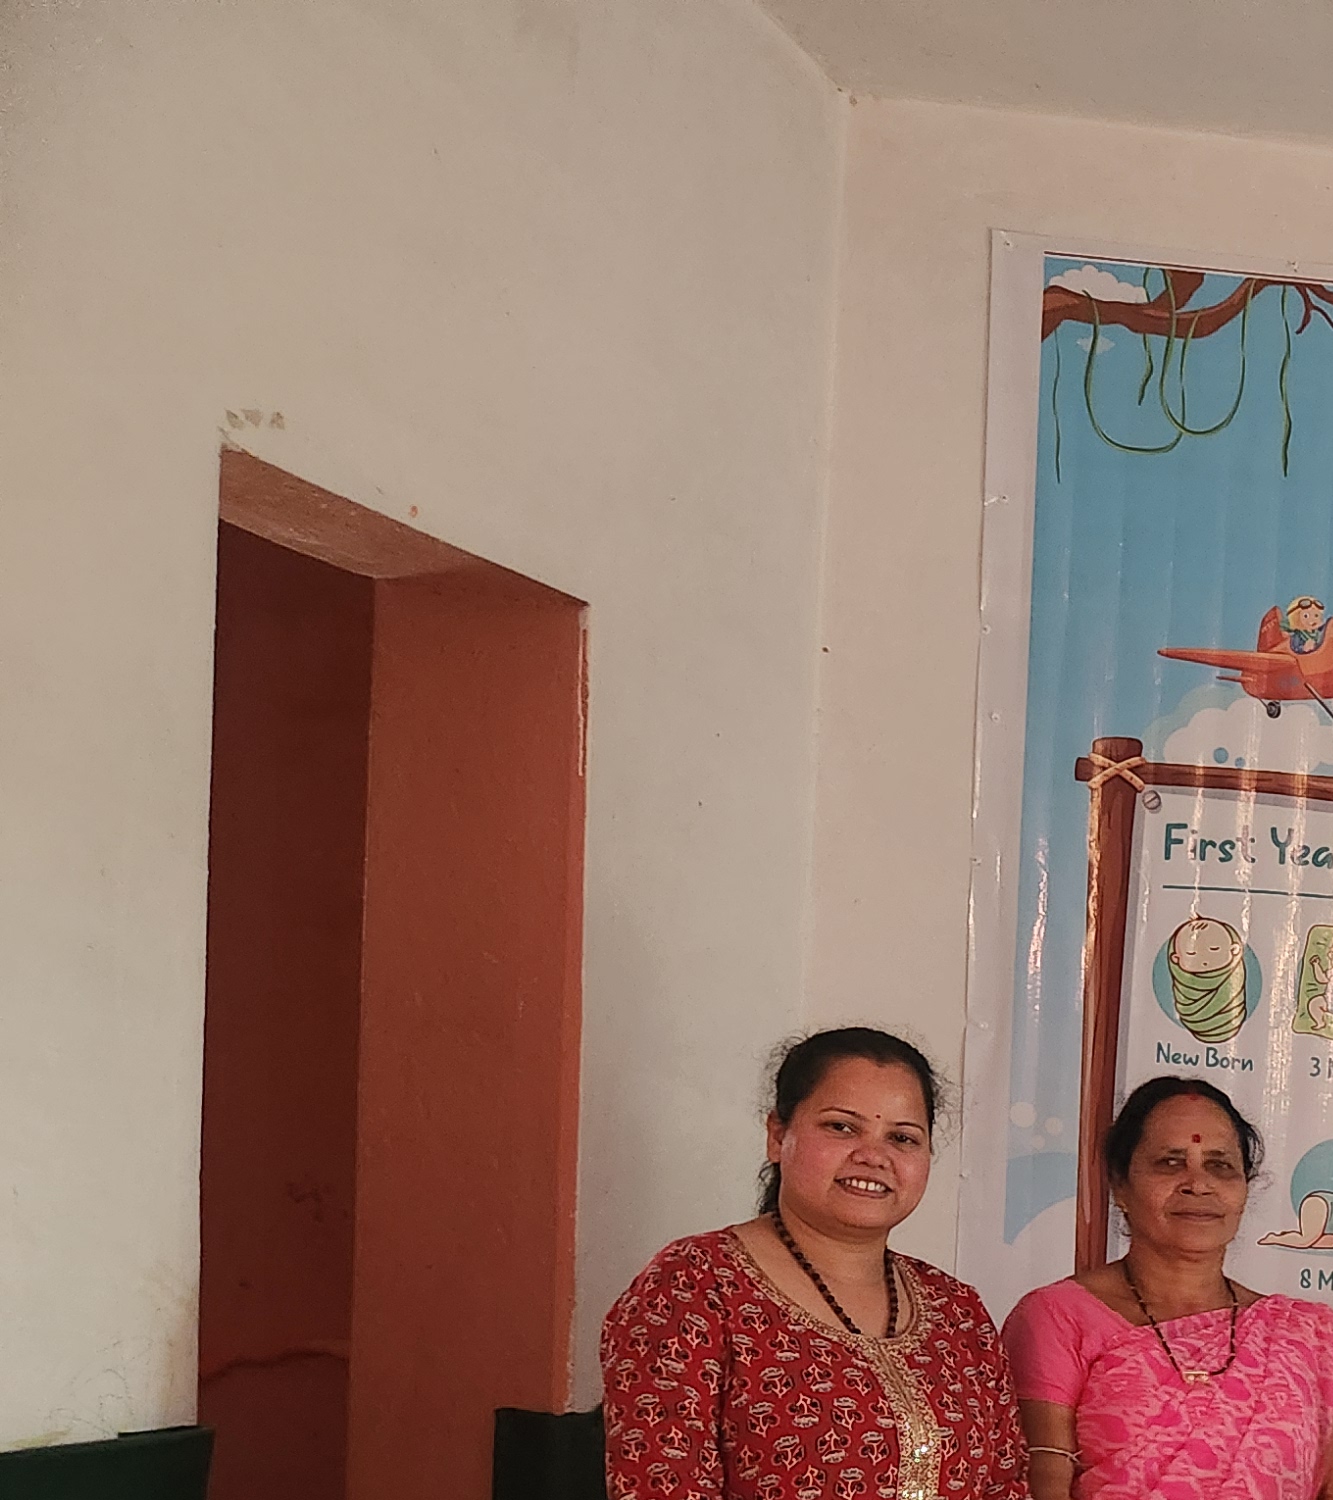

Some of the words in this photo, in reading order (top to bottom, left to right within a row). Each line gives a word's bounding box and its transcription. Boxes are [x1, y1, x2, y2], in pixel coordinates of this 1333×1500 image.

[1163, 823, 1256, 866] First
[1156, 1042, 1199, 1068] New
[1204, 1047, 1254, 1073] Born
[1309, 1057, 1321, 1078] 3
[1300, 1269, 1312, 1289] 8
